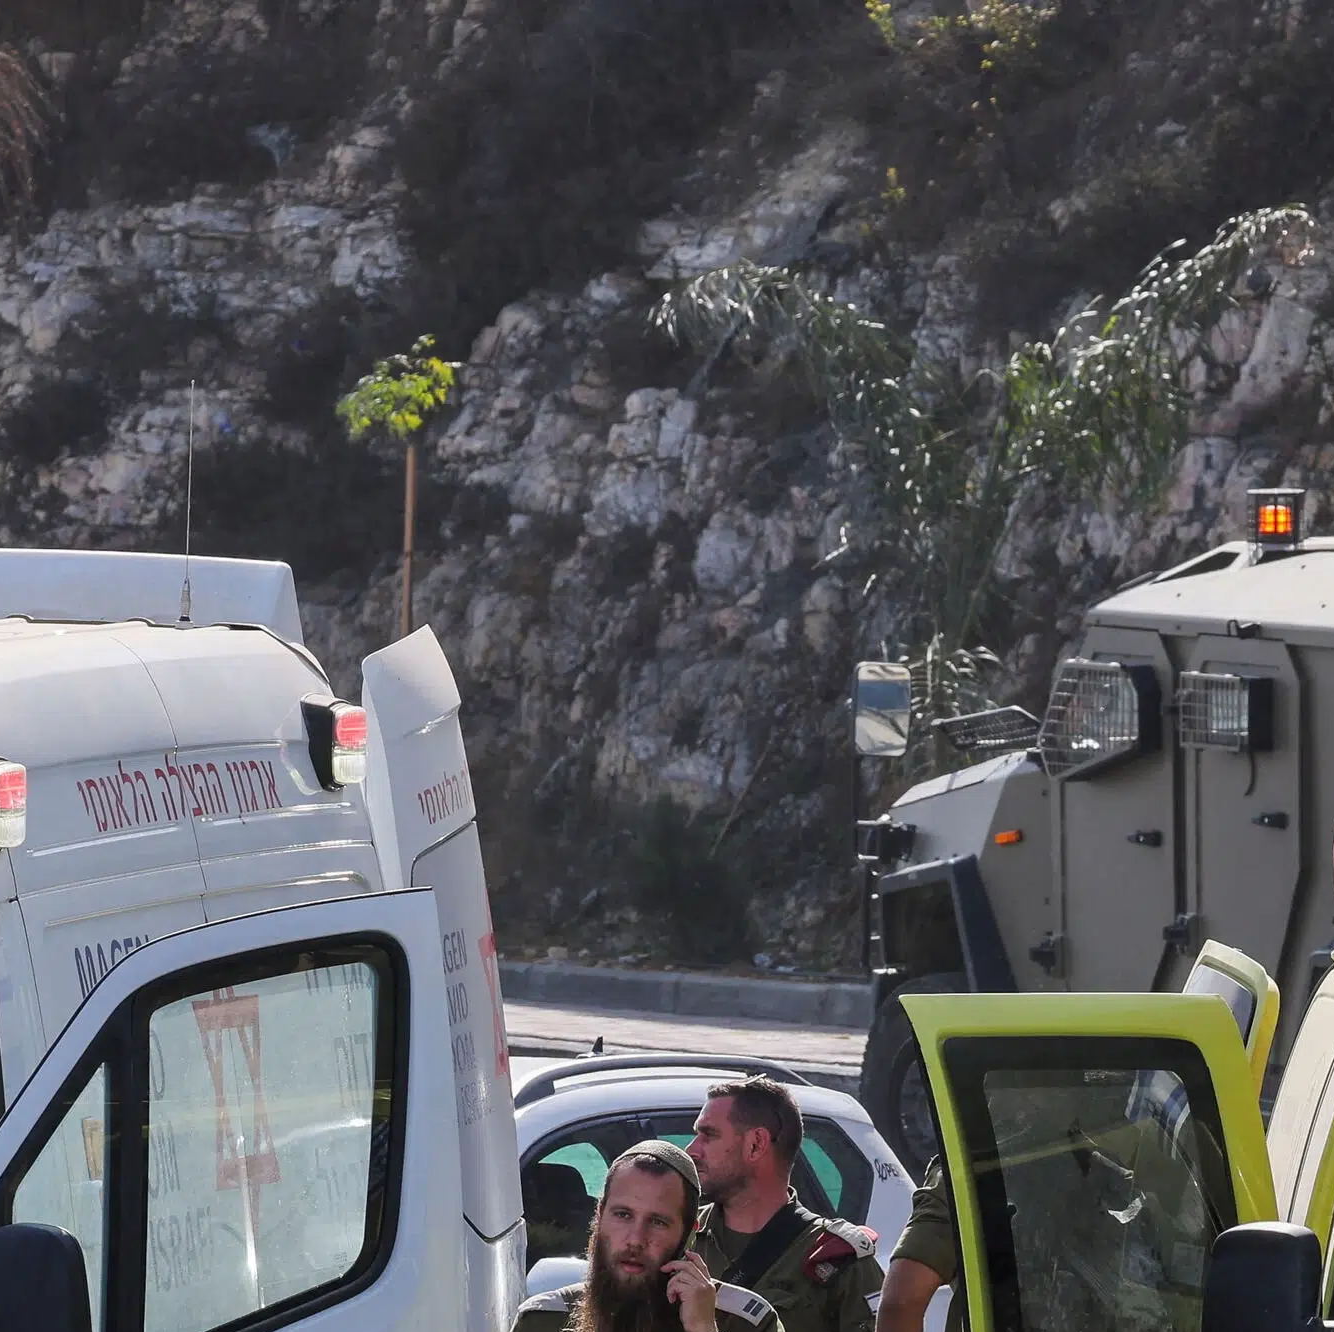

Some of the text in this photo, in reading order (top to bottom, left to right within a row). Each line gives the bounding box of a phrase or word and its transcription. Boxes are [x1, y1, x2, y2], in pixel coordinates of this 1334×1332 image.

[76, 754, 283, 832] ארגון ההצלה הלאומי
